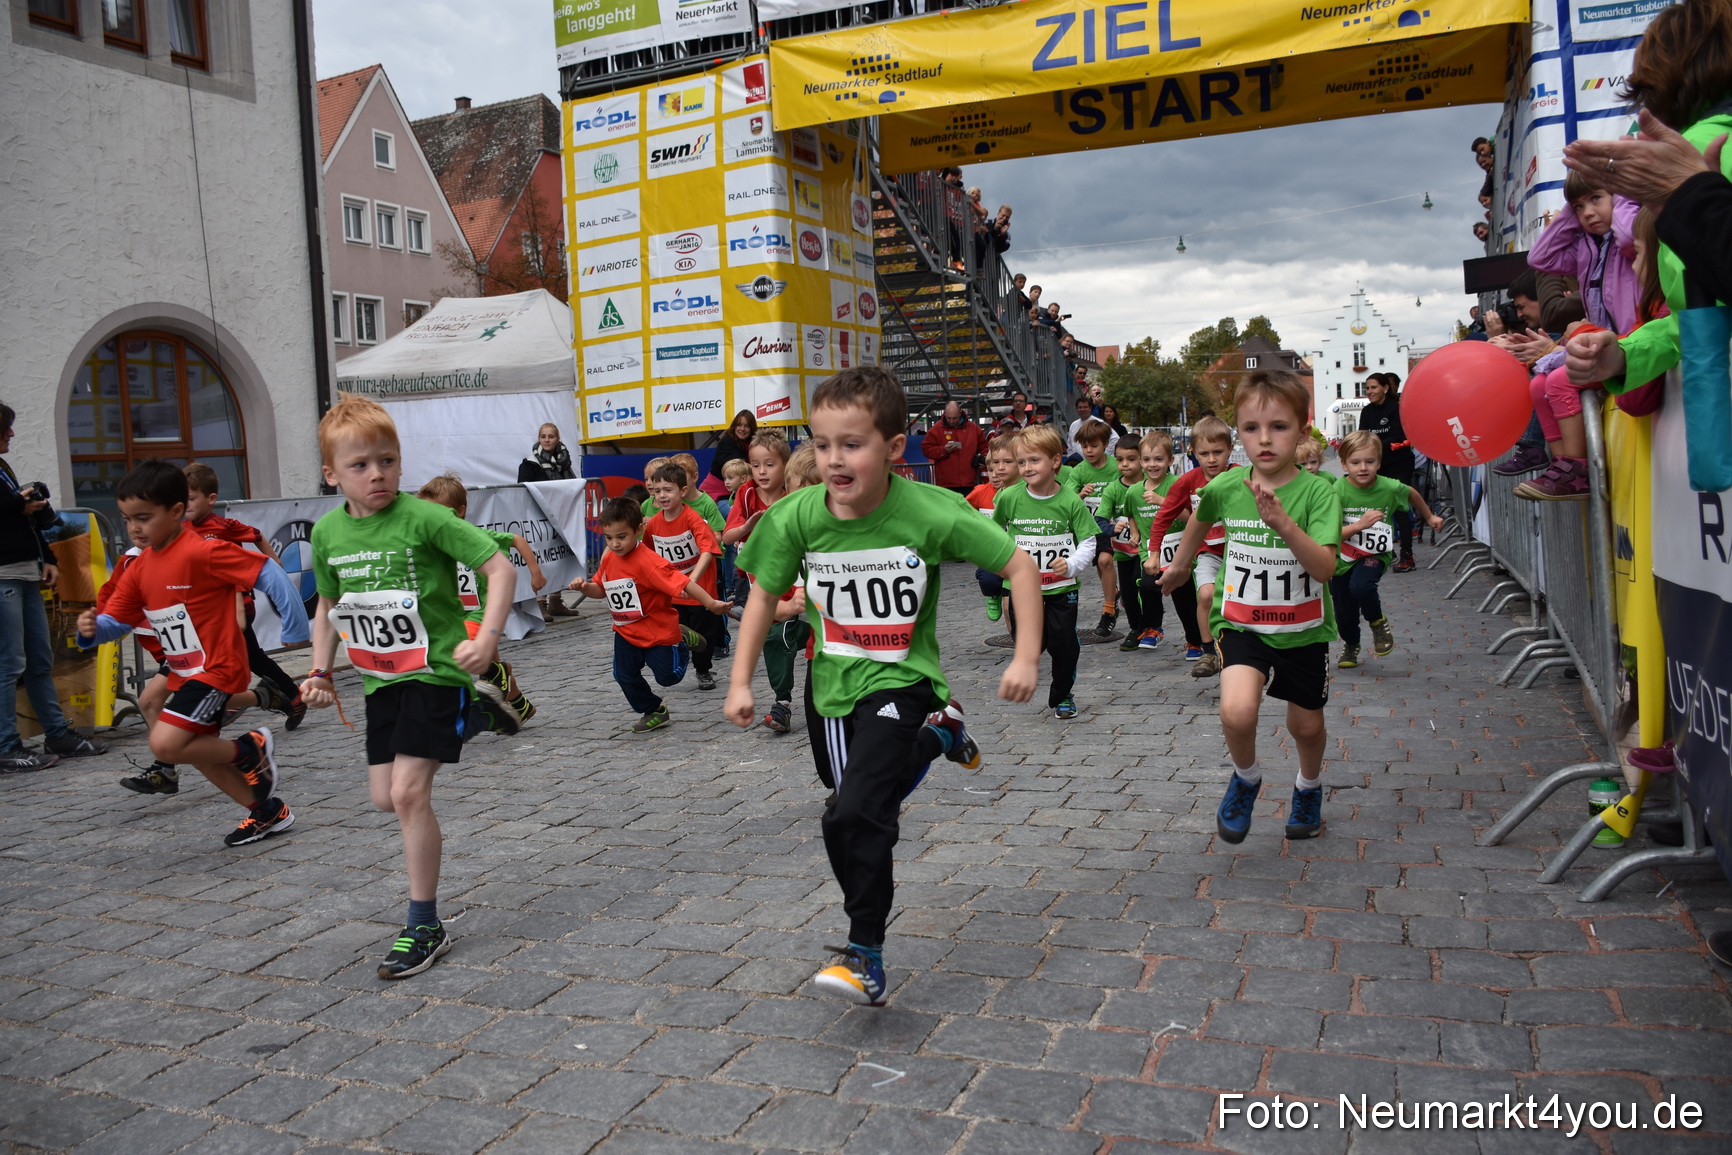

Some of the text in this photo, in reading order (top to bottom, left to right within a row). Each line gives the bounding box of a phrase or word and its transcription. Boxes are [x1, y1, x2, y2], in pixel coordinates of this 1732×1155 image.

[567, 4, 636, 33] langgeht!
[676, 0, 738, 21] NeuerMarkt
[1583, 0, 1671, 20] Neumarkter Tagblatt
[1032, 0, 1200, 71] ZIEL
[803, 63, 944, 95] Neumarkter Stadtlauf
[1325, 63, 1475, 95] Neumarkter Stadtlauf
[684, 102, 703, 112] KANN
[1069, 64, 1284, 136] START
[576, 107, 636, 131] RÖDL
[608, 119, 637, 132] energie
[909, 121, 1033, 147] Neumarkter Stadtlauf
[650, 141, 691, 163] swn
[736, 143, 778, 158] Lammsbräu
[728, 187, 775, 201] RAIL.ONE
[580, 214, 620, 229] RAIL.ONE
[730, 228, 791, 251] RÖDL
[596, 258, 638, 274] VARIOTEC
[679, 260, 693, 269] KIA
[755, 284, 773, 293] MINI
[653, 291, 719, 313] RÖDL
[687, 307, 719, 317] energie
[660, 344, 717, 360] Neumarkter Tagblatt
[586, 362, 625, 376] RAIL.ONE
[590, 401, 642, 424] RÖDL
[672, 399, 722, 413] VARIOTEC
[616, 418, 643, 428] energie
[1016, 540, 1035, 548] PARTL
[1348, 531, 1388, 553] 158
[658, 542, 694, 562] 7191
[1228, 550, 1298, 566] PARTL Neumar
[807, 560, 902, 575] PARTL Neumarkt
[1234, 565, 1312, 601] 7111
[354, 601, 398, 611] Neumarkt
[817, 576, 919, 619] 7106
[1251, 608, 1295, 622] Simon
[337, 613, 418, 648] 7039
